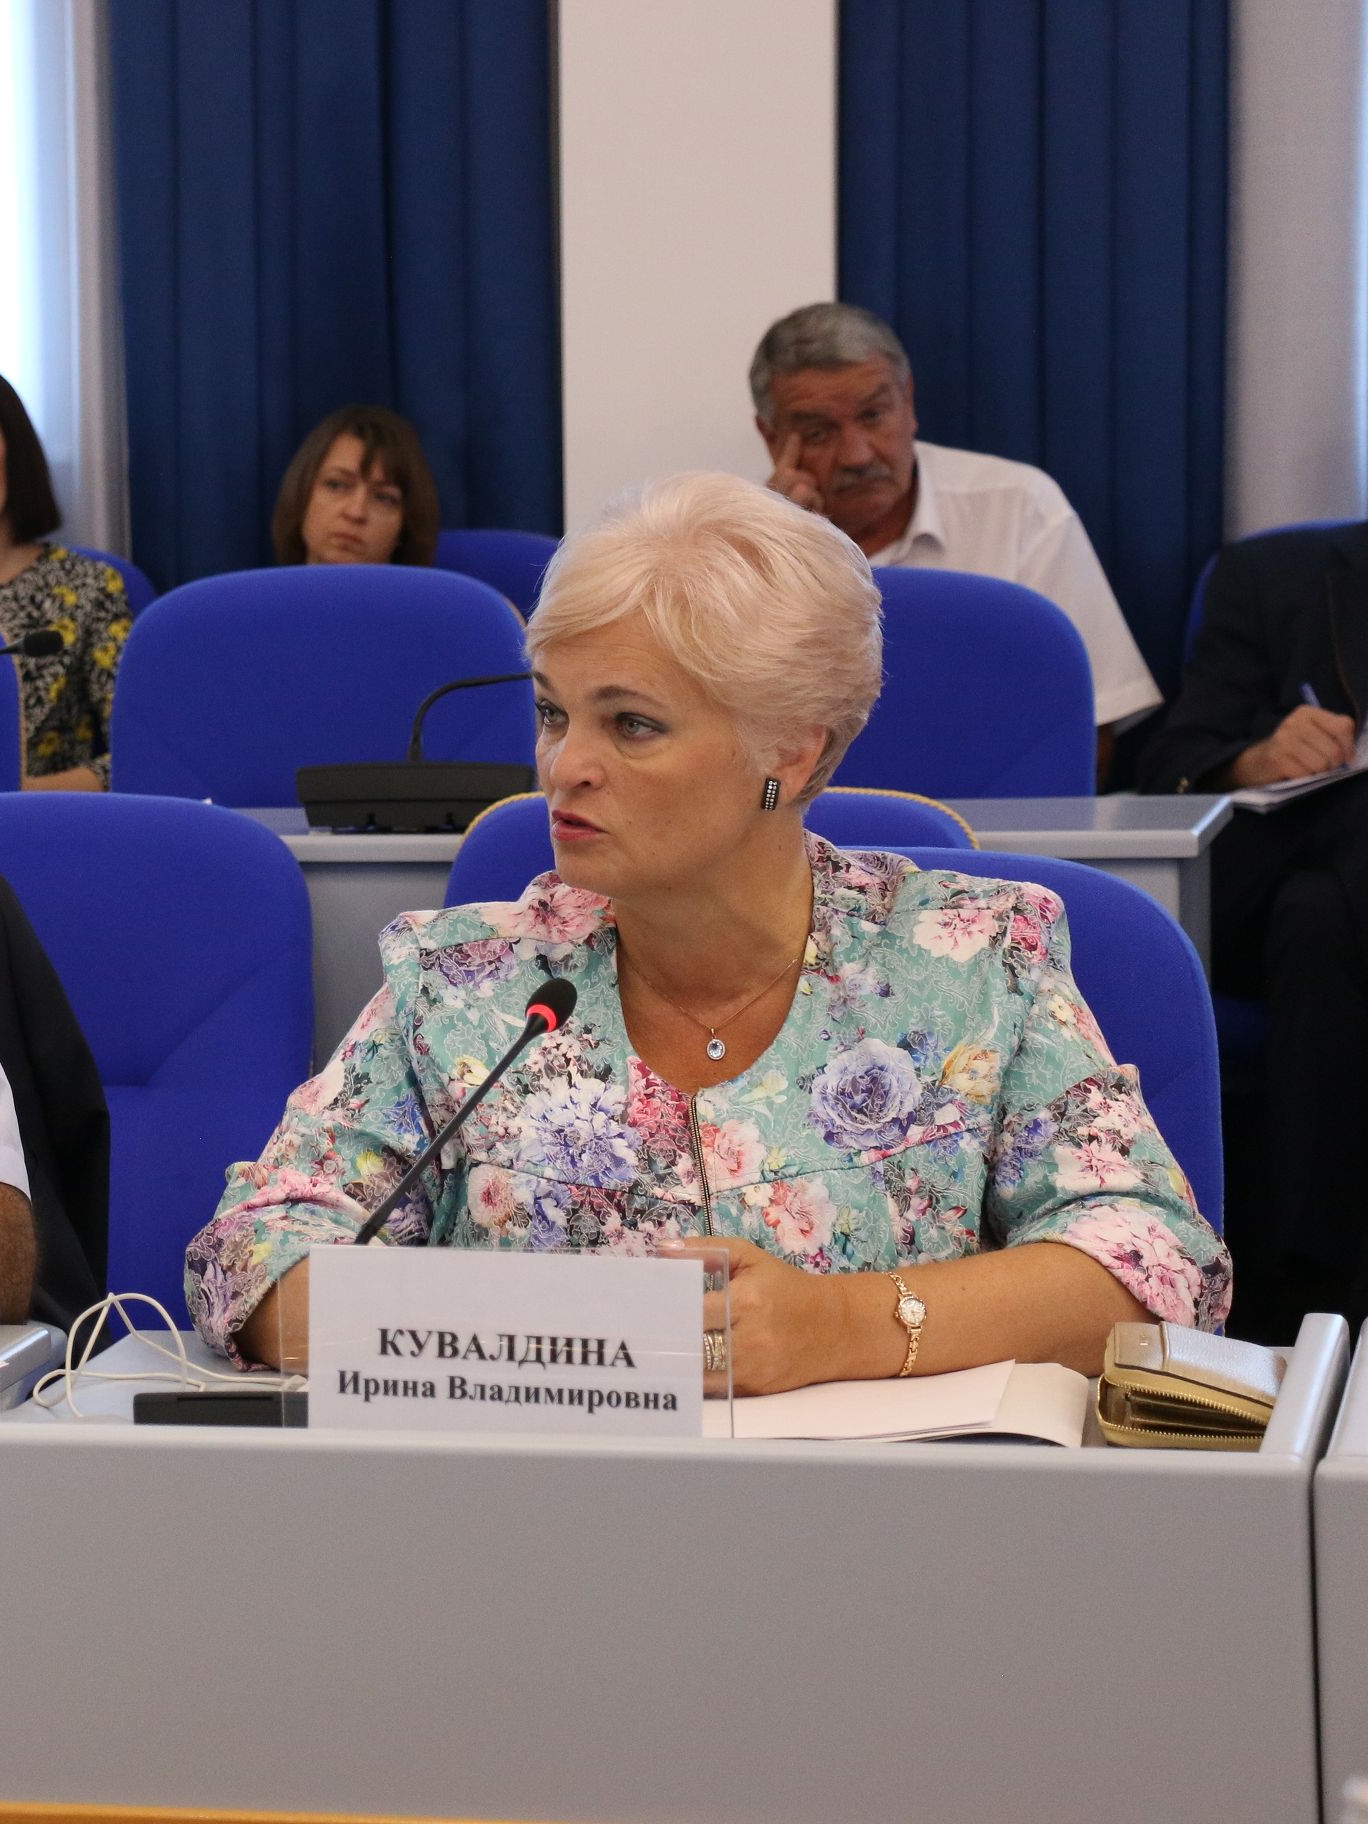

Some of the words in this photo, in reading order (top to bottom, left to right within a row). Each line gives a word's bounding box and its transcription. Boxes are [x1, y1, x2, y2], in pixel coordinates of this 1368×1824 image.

[378, 1328, 636, 1369] КУВАЛДИНА
[337, 1370, 436, 1402] Ирина
[448, 1376, 679, 1413] Владимировна
